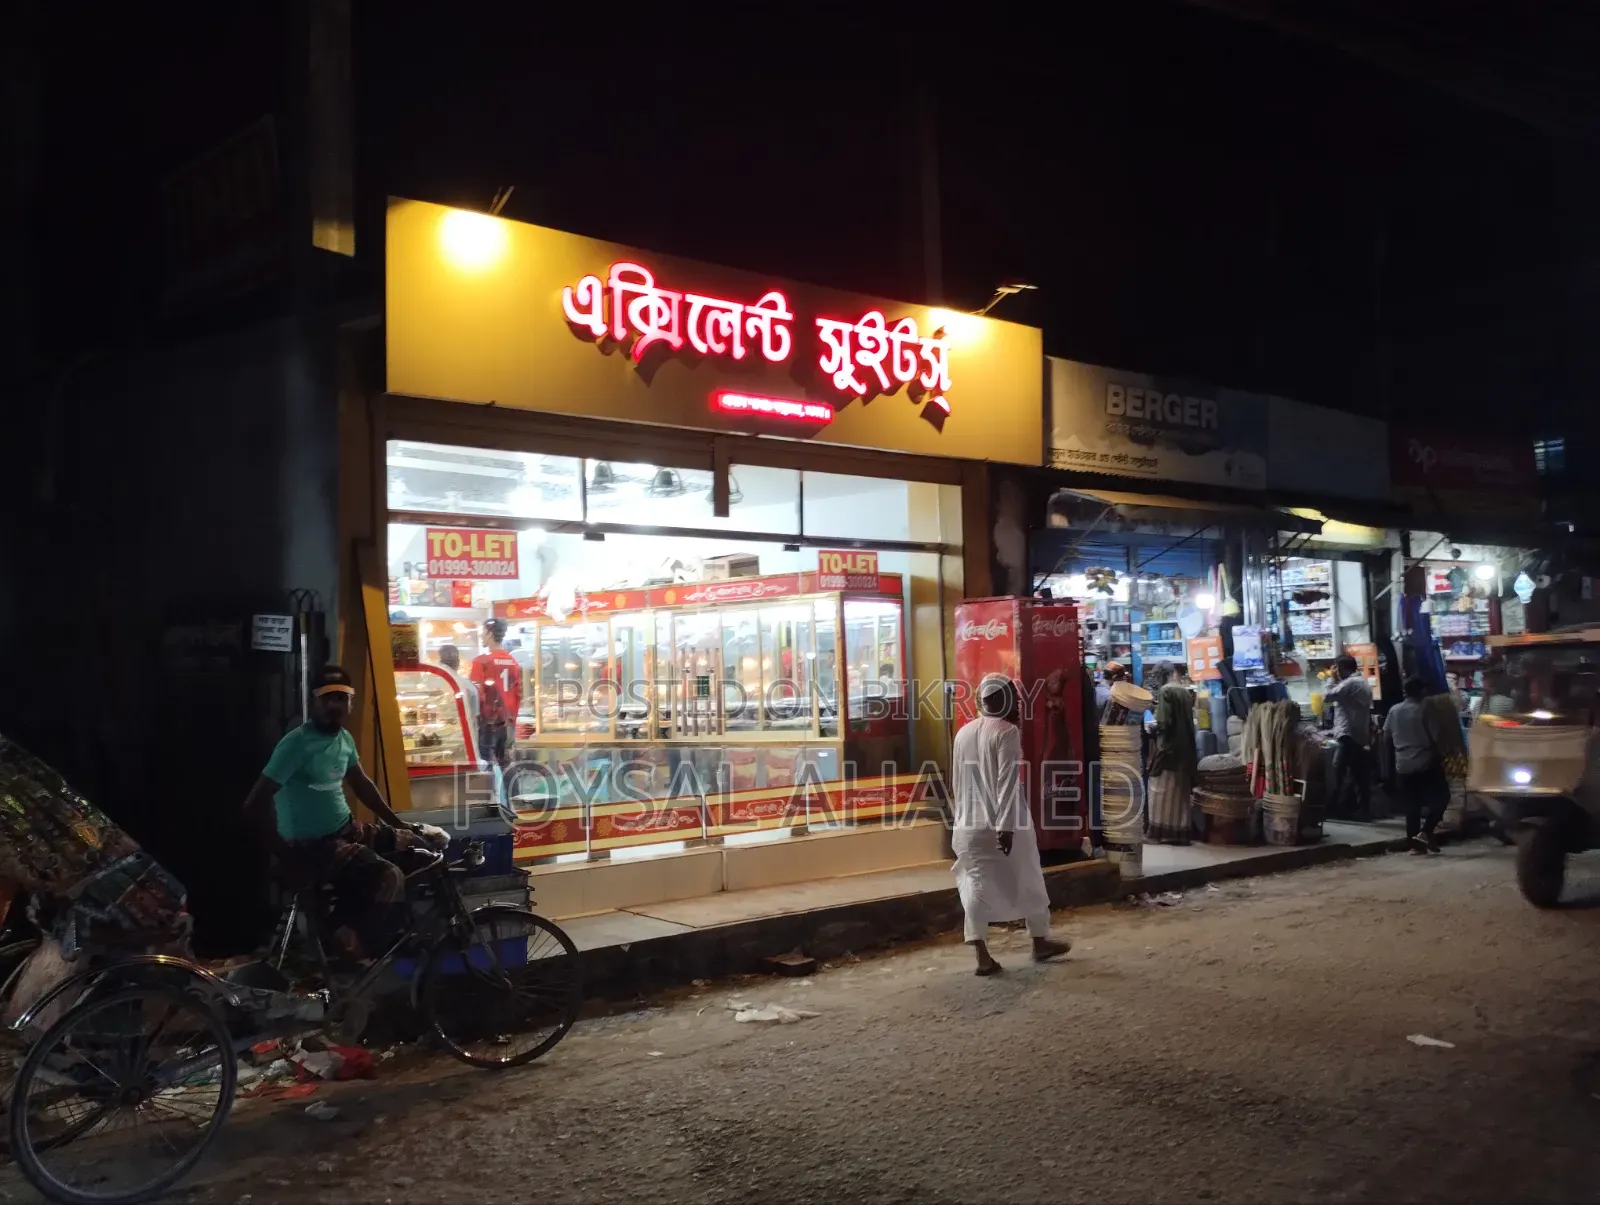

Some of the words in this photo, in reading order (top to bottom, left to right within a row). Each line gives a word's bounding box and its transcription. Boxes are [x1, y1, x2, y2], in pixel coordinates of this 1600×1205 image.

[562, 261, 793, 362] এক্সিলেন্ট
[1104, 382, 1219, 428] BERGER
[428, 532, 516, 558] TO-LET
[819, 553, 877, 574] TO-LET
[499, 668, 509, 692] 1
